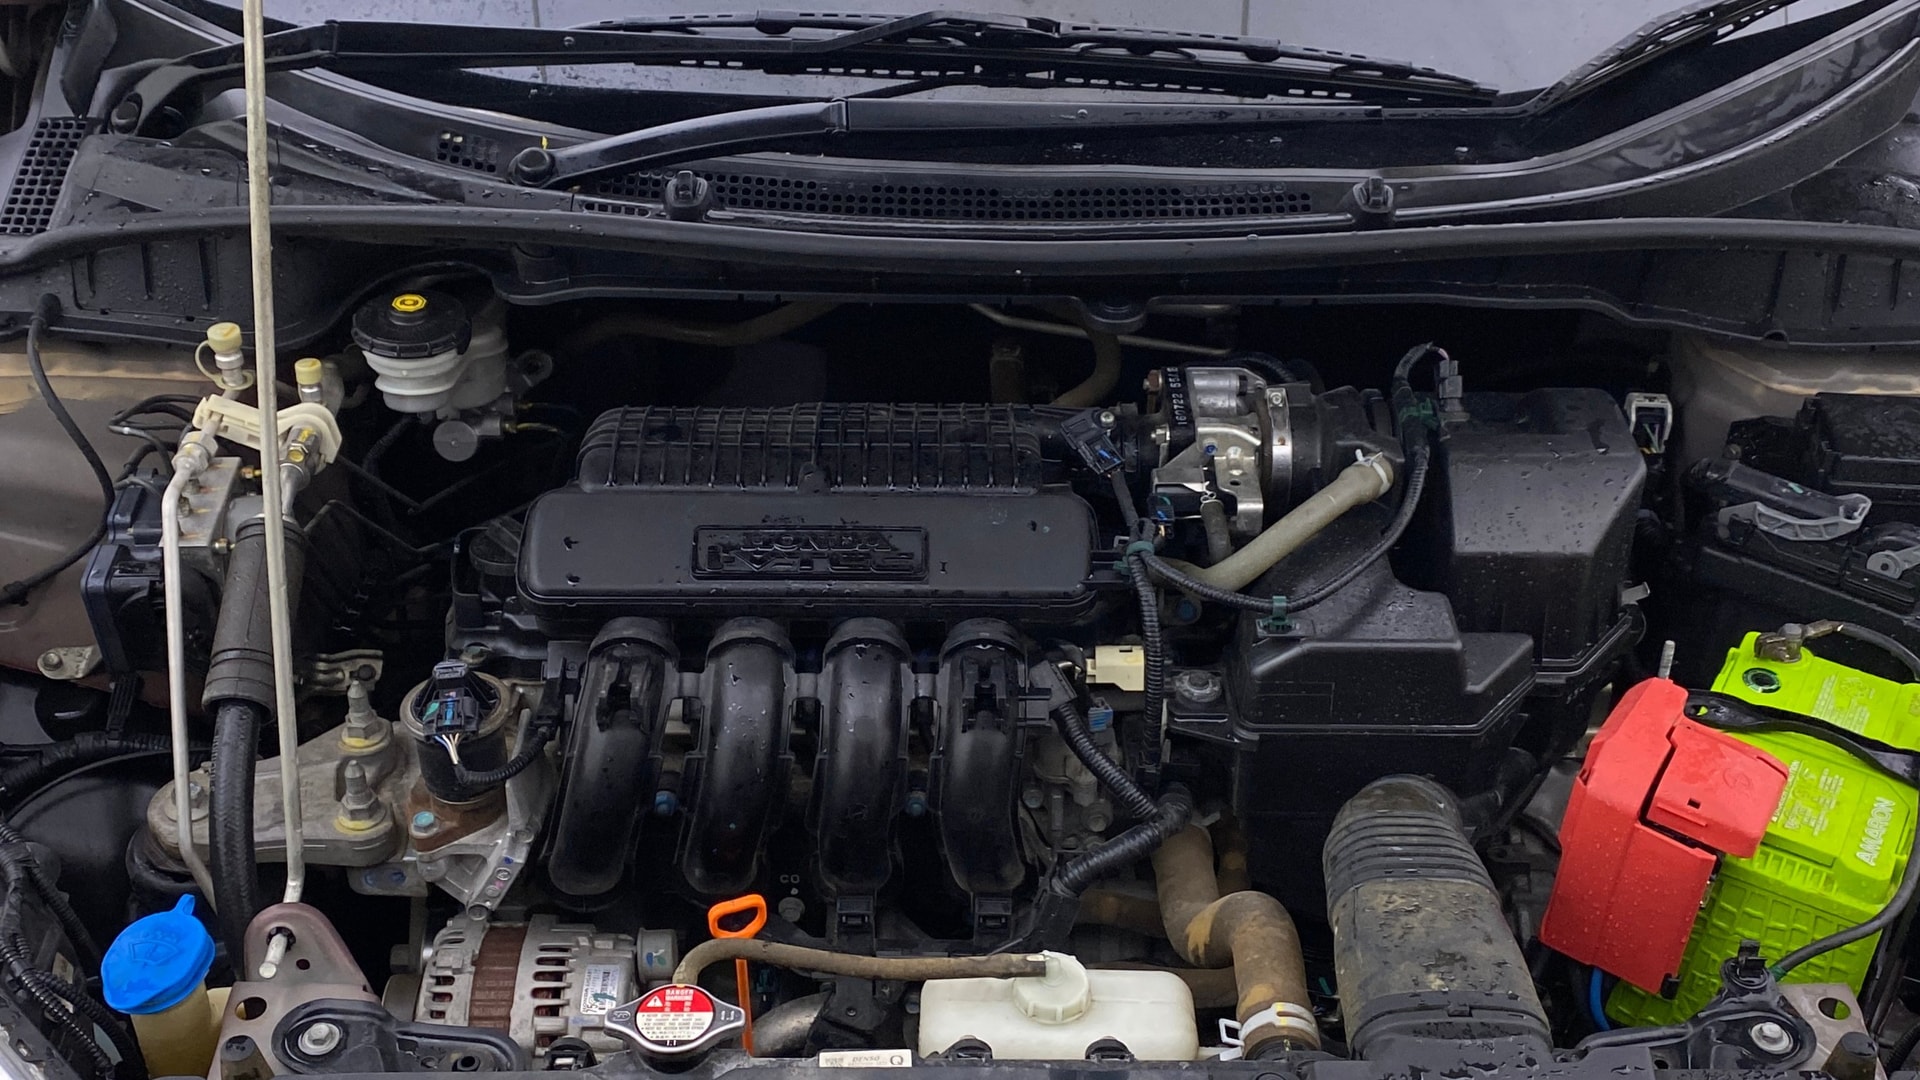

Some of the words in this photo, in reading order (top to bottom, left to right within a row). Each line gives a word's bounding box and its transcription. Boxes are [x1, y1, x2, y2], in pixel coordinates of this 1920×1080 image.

[1171, 393, 1188, 425] 160722
[1855, 796, 1896, 867] AMARON
[852, 1055, 880, 1063] DENSO
[890, 1055, 904, 1066] Q
